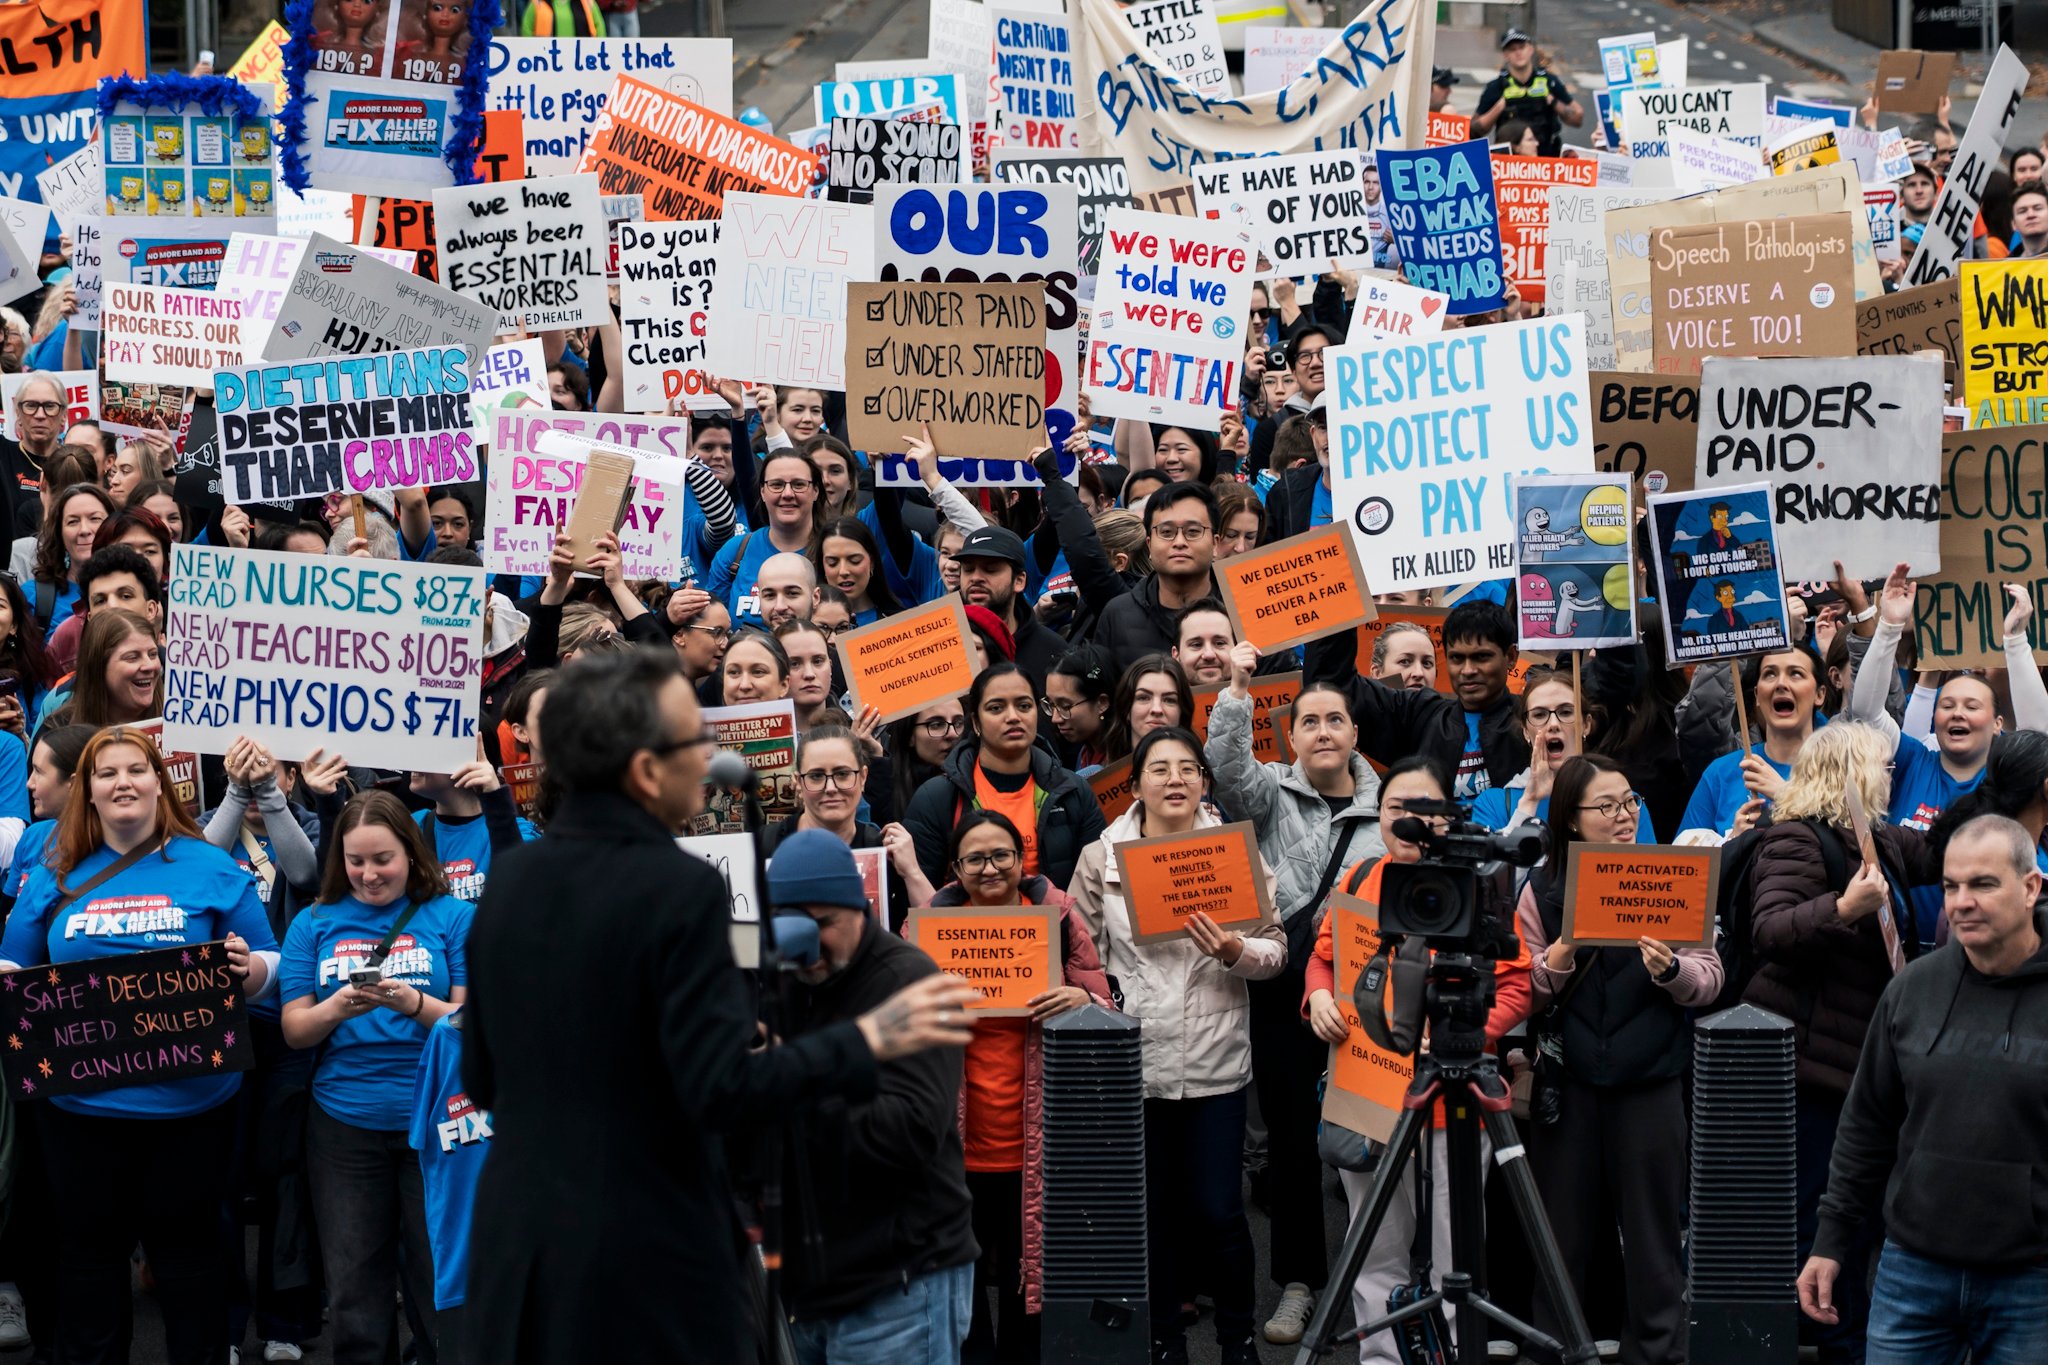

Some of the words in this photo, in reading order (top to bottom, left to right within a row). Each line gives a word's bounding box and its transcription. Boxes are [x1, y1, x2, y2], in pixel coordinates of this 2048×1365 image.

[1126, 0, 1204, 29] LITTLE
[1145, 23, 1197, 47] MISS
[315, 49, 354, 73] 19%
[403, 58, 441, 82] 19%
[622, 41, 676, 71] that
[345, 105, 356, 114] NO
[356, 106, 380, 115] MORE
[381, 107, 403, 116] BAND
[404, 107, 423, 116] AIDS
[604, 79, 708, 154] NUTRITION
[1003, 85, 1042, 118] THE
[1640, 94, 1677, 115] YOU
[1682, 89, 1732, 114] CAN'T
[327, 118, 382, 146] FIX
[385, 118, 438, 132] ALLIED
[384, 130, 438, 145] HEALTH
[831, 118, 877, 152] NO
[881, 120, 960, 159] SONO
[1026, 120, 1065, 147] PAY
[1432, 119, 1465, 140] PILLS
[1718, 117, 1730, 133] A
[608, 124, 707, 188] INADEQUATE
[830, 151, 875, 188] NO
[1679, 142, 1758, 174] PRESCRIPTION
[1196, 172, 1230, 199] WE
[1242, 165, 1297, 193] HAVE
[1310, 160, 1355, 187] HAD
[1389, 152, 1480, 200] EBA
[1554, 162, 1593, 184] PILLS
[521, 186, 572, 209] have
[1268, 199, 1300, 225] OF
[1309, 190, 1367, 220] YOUR
[1500, 187, 1520, 204] NO
[890, 189, 1049, 258] OUR
[1389, 202, 1417, 231] SO
[1420, 193, 1494, 231] WEAK
[526, 221, 583, 244] been
[622, 225, 656, 251] Do
[658, 228, 707, 259] you
[1274, 226, 1369, 262] OFFERS
[1399, 236, 1415, 257] IT
[1422, 228, 1494, 261] NEEDS
[1110, 230, 1158, 259] we
[1168, 238, 1247, 274] were
[1657, 227, 1730, 278] Speech
[1745, 221, 1846, 273] Pathologists
[448, 247, 602, 291] ESSENTIAL
[1115, 263, 1178, 299] told
[1189, 278, 1227, 307] we
[112, 288, 156, 313] OUR
[164, 293, 242, 320] PATIENTS
[479, 279, 579, 312] WORKERS
[892, 289, 963, 328] UNDER
[975, 294, 1037, 329] PAID
[1668, 283, 1751, 310] DESERVE
[1770, 281, 1784, 301] A
[108, 313, 202, 340] PROGRESS.
[204, 323, 240, 345] OUR
[543, 309, 582, 323] HEALTH
[1124, 302, 1204, 334] were
[1362, 305, 1413, 336] FAIR
[624, 323, 685, 345] This
[1667, 319, 1736, 351] VOICE
[1750, 314, 1802, 345] TOO!
[109, 340, 145, 369] PAY
[152, 343, 214, 370] SHOULD
[893, 344, 963, 379] UNDER
[973, 349, 1046, 379] STAFFED
[1335, 334, 1488, 411] RESPECT
[1518, 322, 1572, 383] US
[213, 346, 470, 414] DIETITIANS
[1088, 340, 1238, 412] ESSENTIAL
[1993, 371, 2044, 394] BUT
[888, 386, 1042, 430] OVERWORKED
[1717, 381, 1901, 430] UNDER-
[222, 397, 397, 452] DESERVE
[398, 393, 473, 435] MORE
[1339, 404, 1492, 480] PROTECT
[1525, 391, 1580, 451] US
[225, 442, 344, 501] THAN
[344, 431, 476, 492] CRUMBS
[1419, 475, 1488, 538] PAY
[1587, 516, 1626, 527] PATIENTS
[1589, 504, 1623, 515] HELPING
[1392, 556, 1418, 581] FIX
[1424, 549, 1476, 577] ALLIED
[1692, 554, 1709, 566] VIC
[1732, 550, 1747, 561] AM
[1983, 525, 2032, 573] IS
[1240, 574, 1264, 586] WE
[1264, 555, 1314, 579] DELIVER
[1315, 545, 1340, 560] THE
[1689, 566, 1707, 578] OUT
[1709, 565, 1721, 576] OF
[1721, 560, 1758, 574] TOUCH?
[171, 582, 238, 608] GRAD
[176, 550, 236, 579] NEW
[245, 560, 403, 620] NURSES
[1266, 572, 1319, 597] RESULTS
[1255, 595, 1306, 621] DELIVER
[1308, 592, 1319, 604] A
[1319, 582, 1348, 601] FAIR
[1295, 611, 1320, 628] EBA
[1712, 633, 1728, 643] THE
[1728, 627, 1777, 641] HEALTHCARE
[170, 610, 228, 642] NEW
[232, 621, 391, 675] TEACHERS
[860, 631, 915, 656] ABNORMAL
[914, 617, 953, 639] RESULT:
[1676, 645, 1717, 658] WORKERS
[1717, 642, 1737, 654] WHO
[1738, 640, 1755, 651] ARE
[1755, 636, 1785, 648] WRONG
[168, 640, 230, 671] GRAD
[864, 655, 907, 678] MEDICAL
[907, 637, 959, 663] SCIENTISTS
[880, 662, 954, 694] UNDERVALUED!
[169, 669, 226, 701] NEW
[233, 677, 397, 739] PHYSIOS
[1278, 693, 1291, 705] IS
[164, 698, 231, 734] GRAD
[729, 721, 761, 732] BETTER
[763, 717, 783, 729] PAY
[1153, 854, 1168, 864] WE
[1170, 847, 1213, 862] RESPOND
[1215, 845, 1226, 855] IN
[1596, 863, 1623, 874] MTP
[1626, 864, 1699, 877] ACTIVATED:
[1163, 892, 1181, 903] THE
[1181, 889, 1200, 901] EBA
[1201, 884, 1233, 898] TAKEN
[1173, 876, 1195, 888] WHY
[1196, 874, 1217, 886] HAS
[1619, 881, 1673, 892] MASSIVE
[99, 902, 123, 912] MORE
[123, 901, 145, 910] BAND
[146, 899, 167, 908] AIDS
[1600, 897, 1689, 911] TRANSFUSION,
[1616, 913, 1643, 924] TINY
[1646, 914, 1671, 925] PAY
[65, 912, 127, 942] FIX
[127, 906, 185, 921] ALLIED
[126, 918, 184, 934] HEALTH
[155, 934, 186, 943] VAHPA
[937, 929, 1006, 941] ESSENTIAL
[1010, 928, 1037, 940] FOR
[951, 947, 1015, 960] PATIENTS
[24, 981, 85, 1013] SAFE
[106, 965, 232, 1004] DECISIONS
[1016, 967, 1033, 979] TO
[54, 1019, 117, 1047] NEED
[134, 1007, 214, 1037] SKILLED
[70, 1045, 203, 1080] CLINICIANS
[1352, 1045, 1368, 1060] EBA
[1371, 1053, 1413, 1079] OVERDUE
[437, 1109, 495, 1152] FIX
